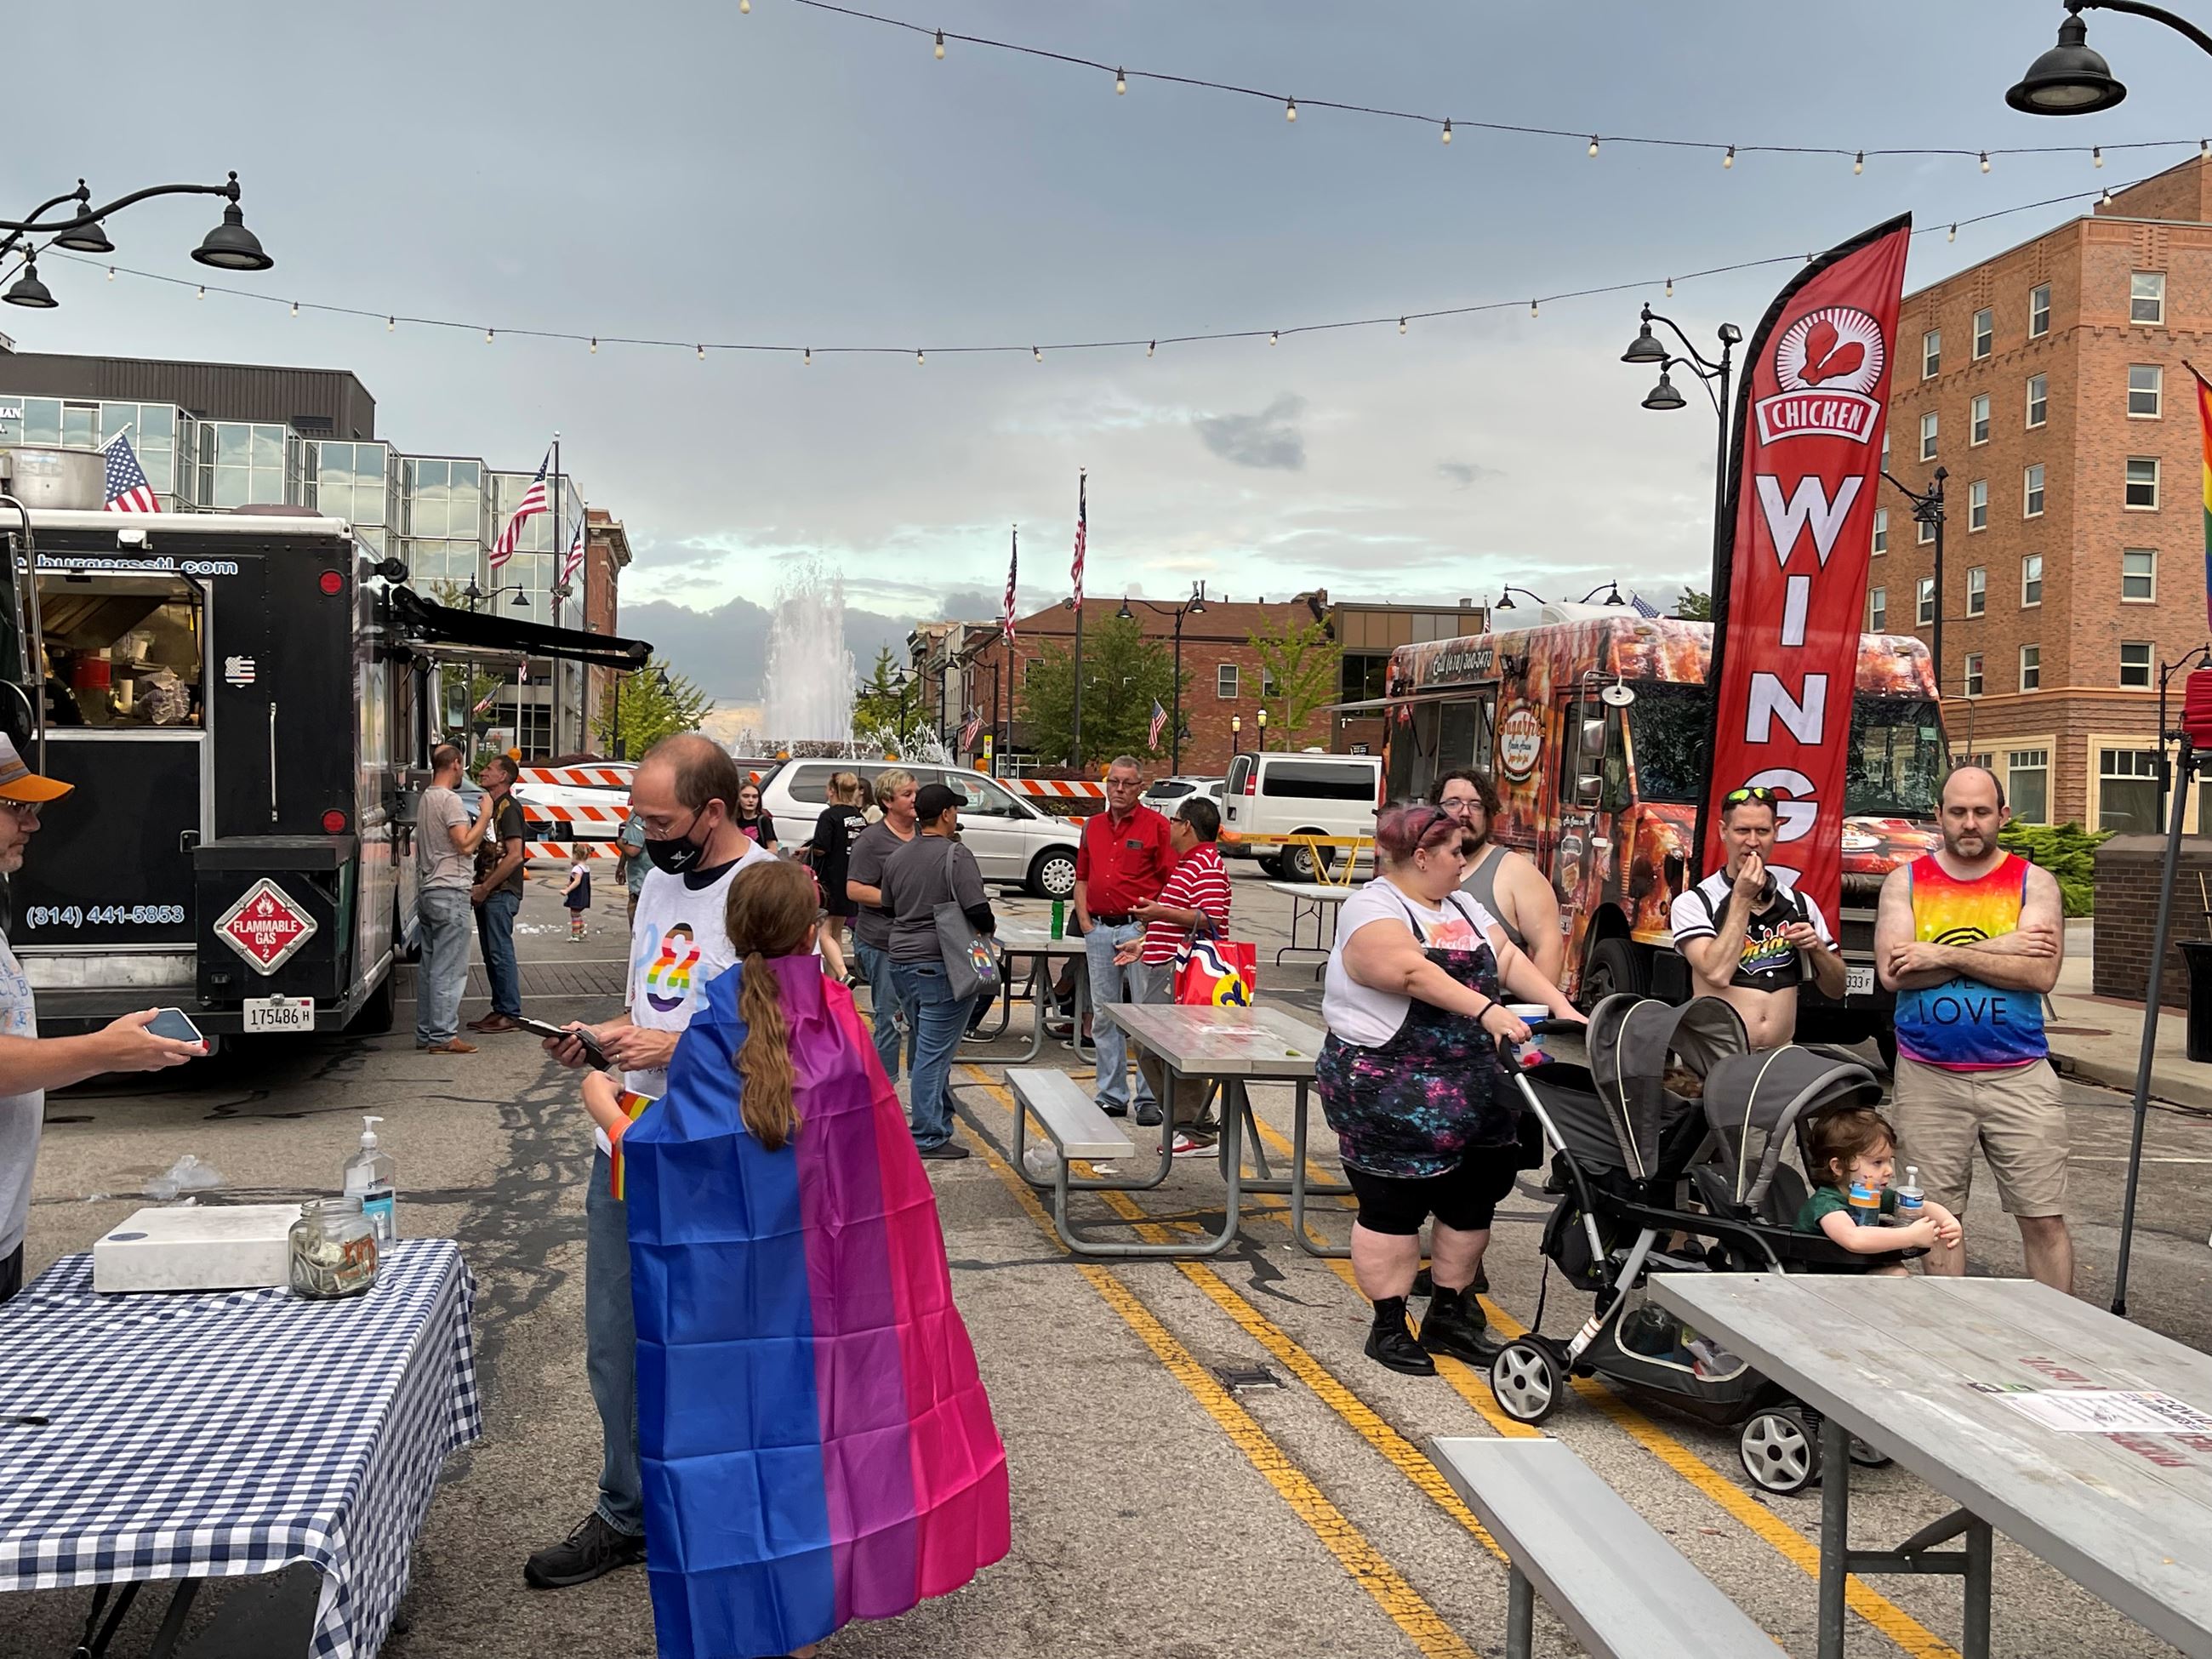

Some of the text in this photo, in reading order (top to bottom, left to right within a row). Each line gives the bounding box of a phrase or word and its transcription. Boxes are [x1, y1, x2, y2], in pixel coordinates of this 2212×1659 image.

[0, 408, 21, 418] AN
[1771, 400, 1864, 432] CHICKEN
[1743, 474, 1865, 889] WING
[26, 905, 185, 929] (314) 441-5853
[233, 920, 298, 933] FLAMMABLE
[255, 932, 276, 944] GAS
[262, 948, 270, 958] 2
[250, 1008, 310, 1025] 175486 H
[1918, 996, 2008, 1026] LOVE
